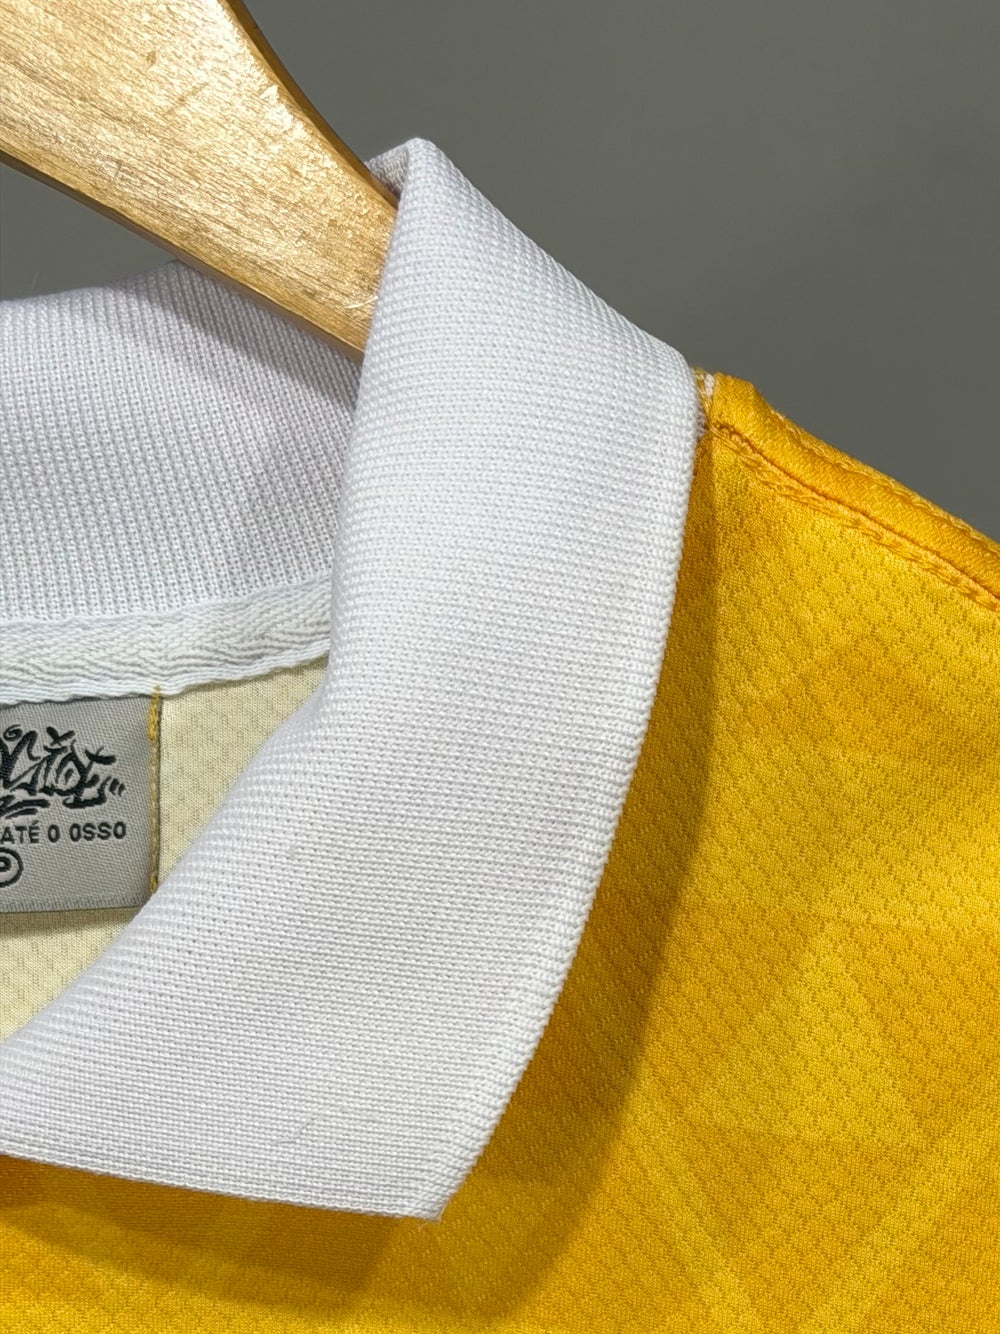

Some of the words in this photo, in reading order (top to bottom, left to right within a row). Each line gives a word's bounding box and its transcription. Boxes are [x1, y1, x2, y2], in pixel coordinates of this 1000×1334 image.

[0, 820, 40, 844] ATÉ
[47, 824, 60, 843] O
[69, 821, 127, 842] OSSO
